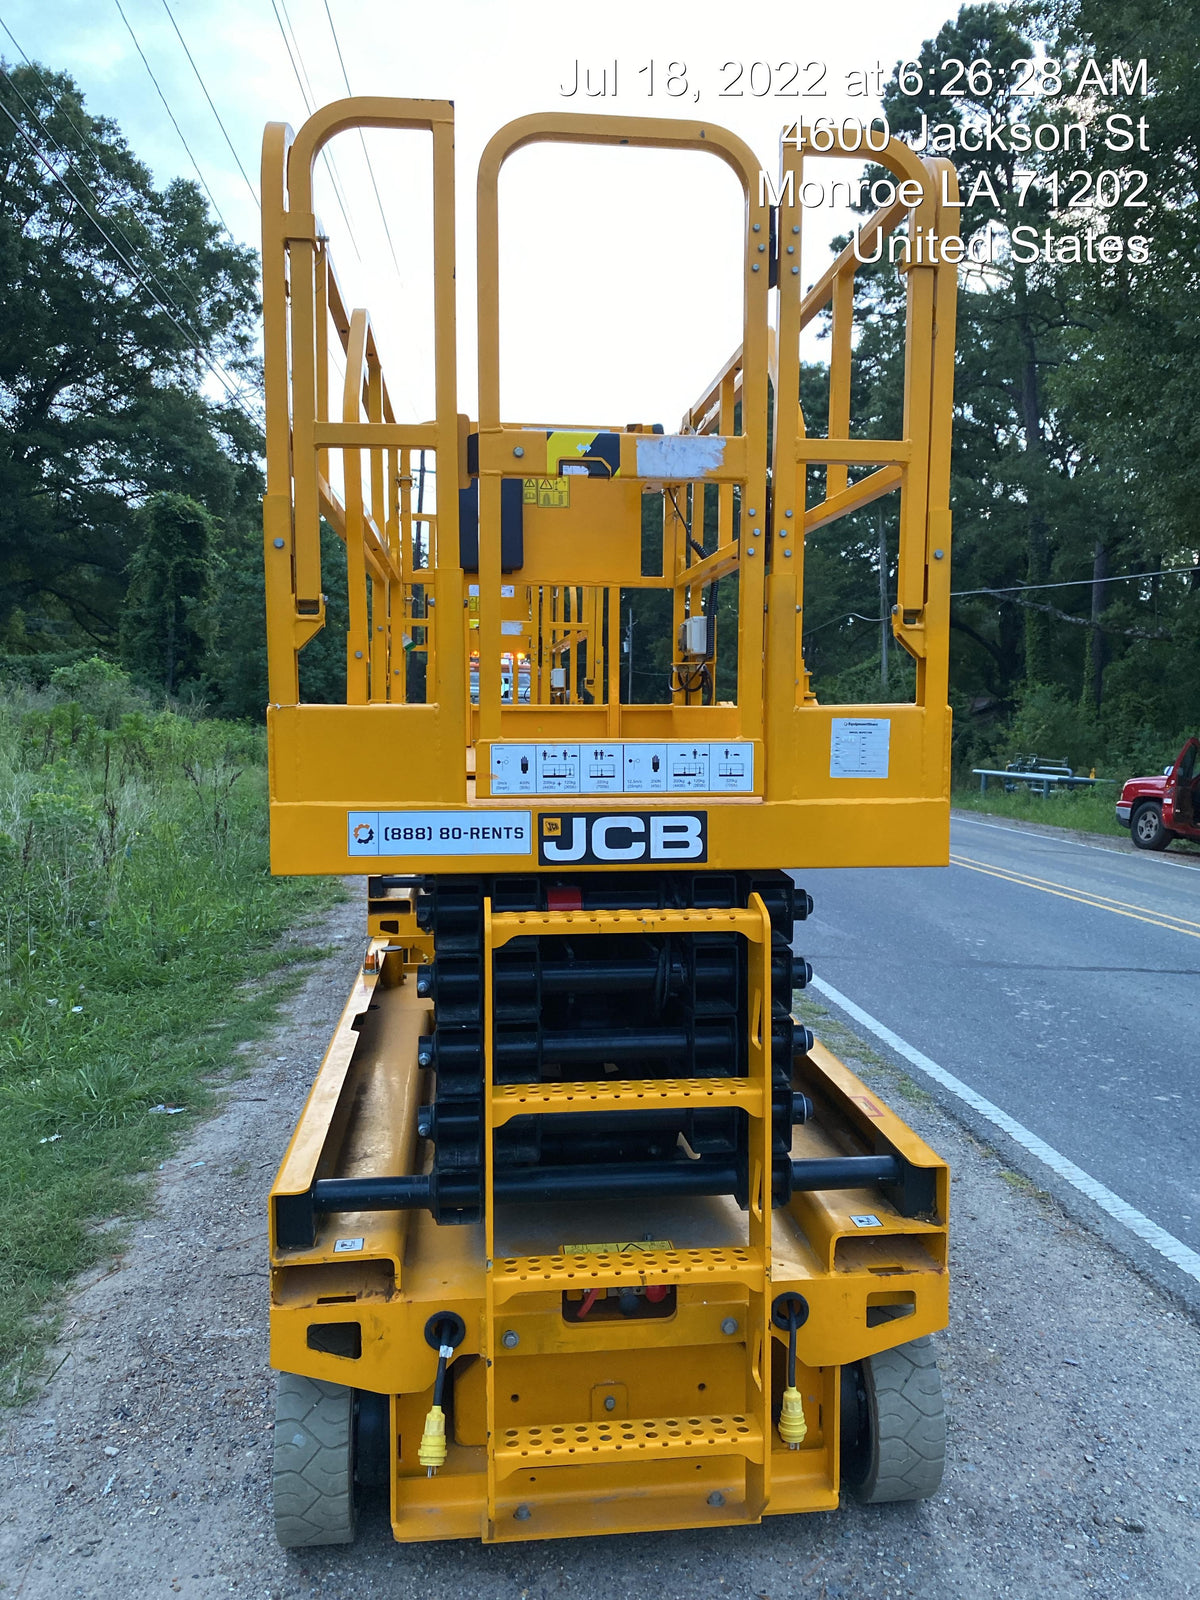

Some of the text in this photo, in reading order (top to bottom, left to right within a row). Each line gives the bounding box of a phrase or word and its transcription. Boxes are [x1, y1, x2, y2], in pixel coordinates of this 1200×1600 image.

[384, 825, 524, 841] (888) 80-RENTS
[543, 816, 704, 861] JCB
